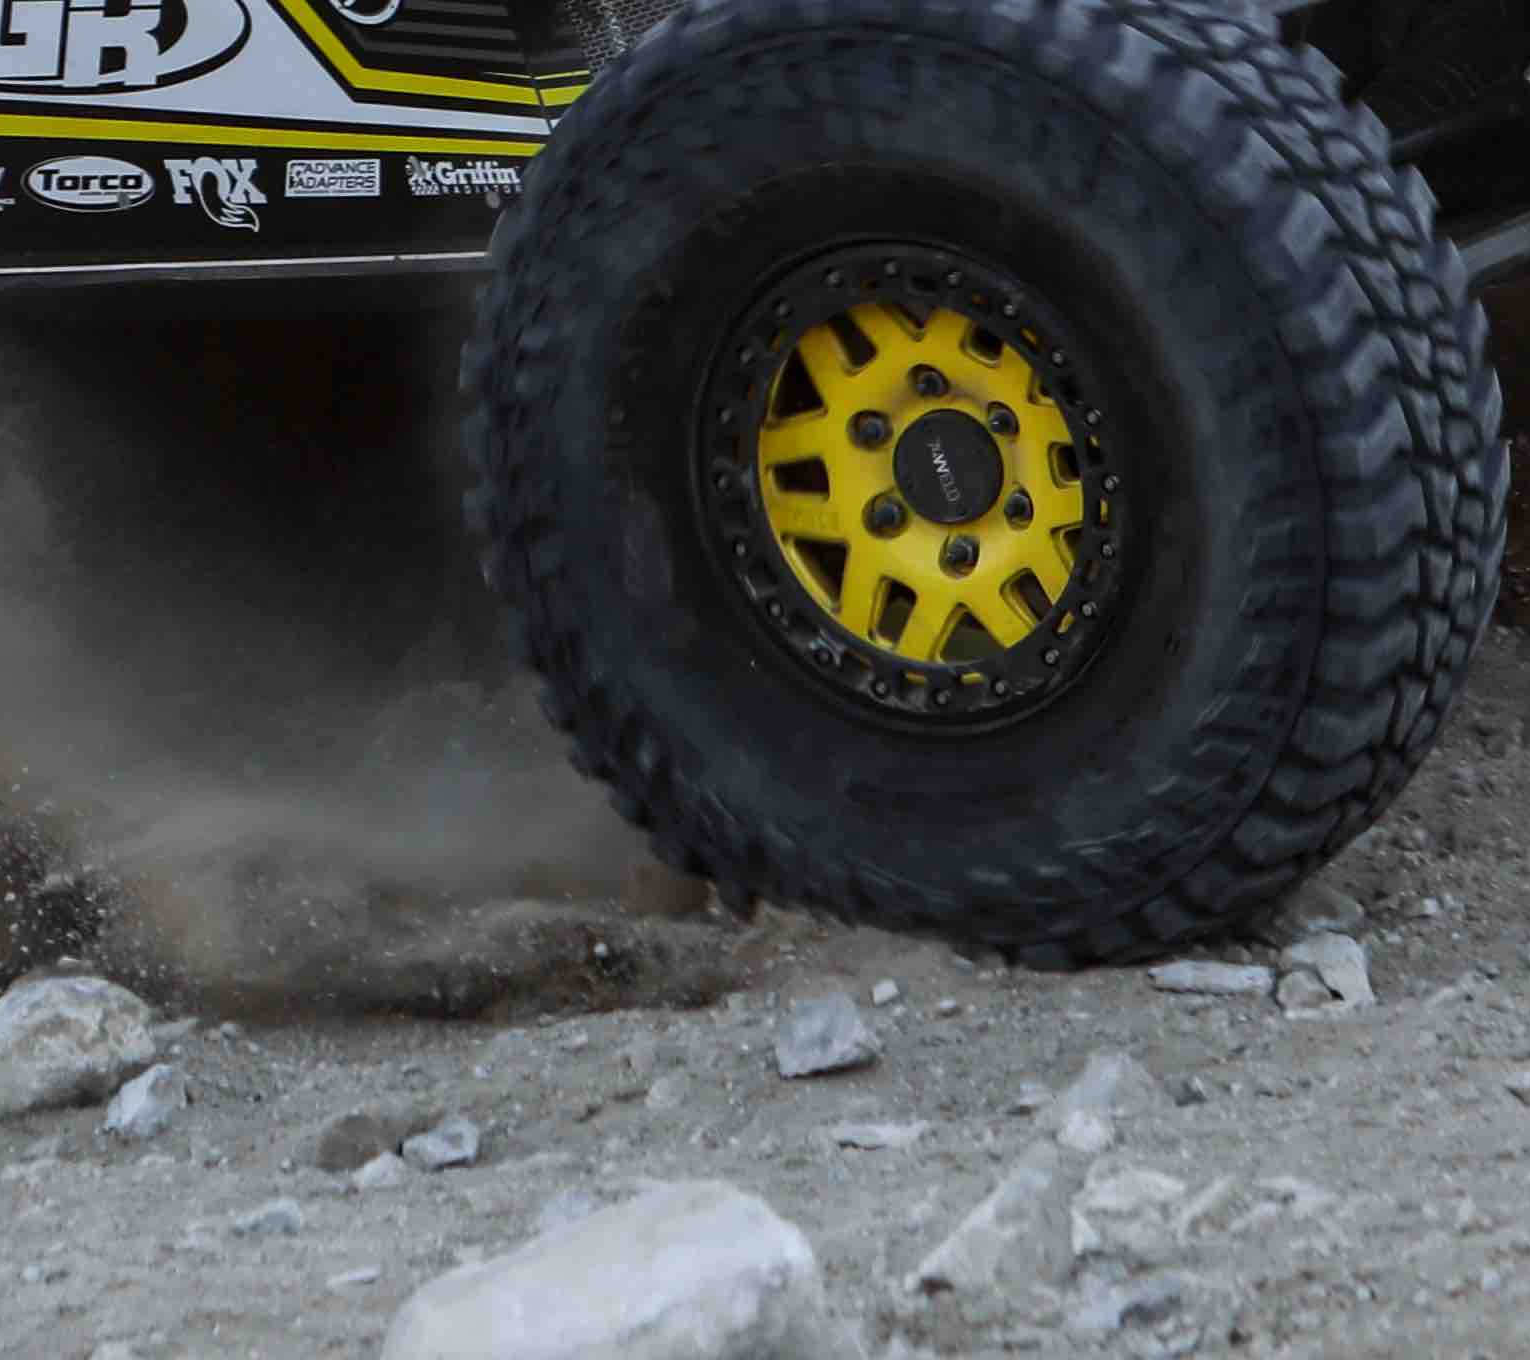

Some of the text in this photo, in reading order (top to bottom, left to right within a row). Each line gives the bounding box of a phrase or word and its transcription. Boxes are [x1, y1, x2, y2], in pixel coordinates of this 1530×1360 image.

[303, 161, 376, 174] ADVANCE
[436, 160, 521, 185] Griffin
[37, 168, 143, 191] Torco
[164, 156, 268, 210] FOX
[299, 175, 376, 189] ADAPTERS
